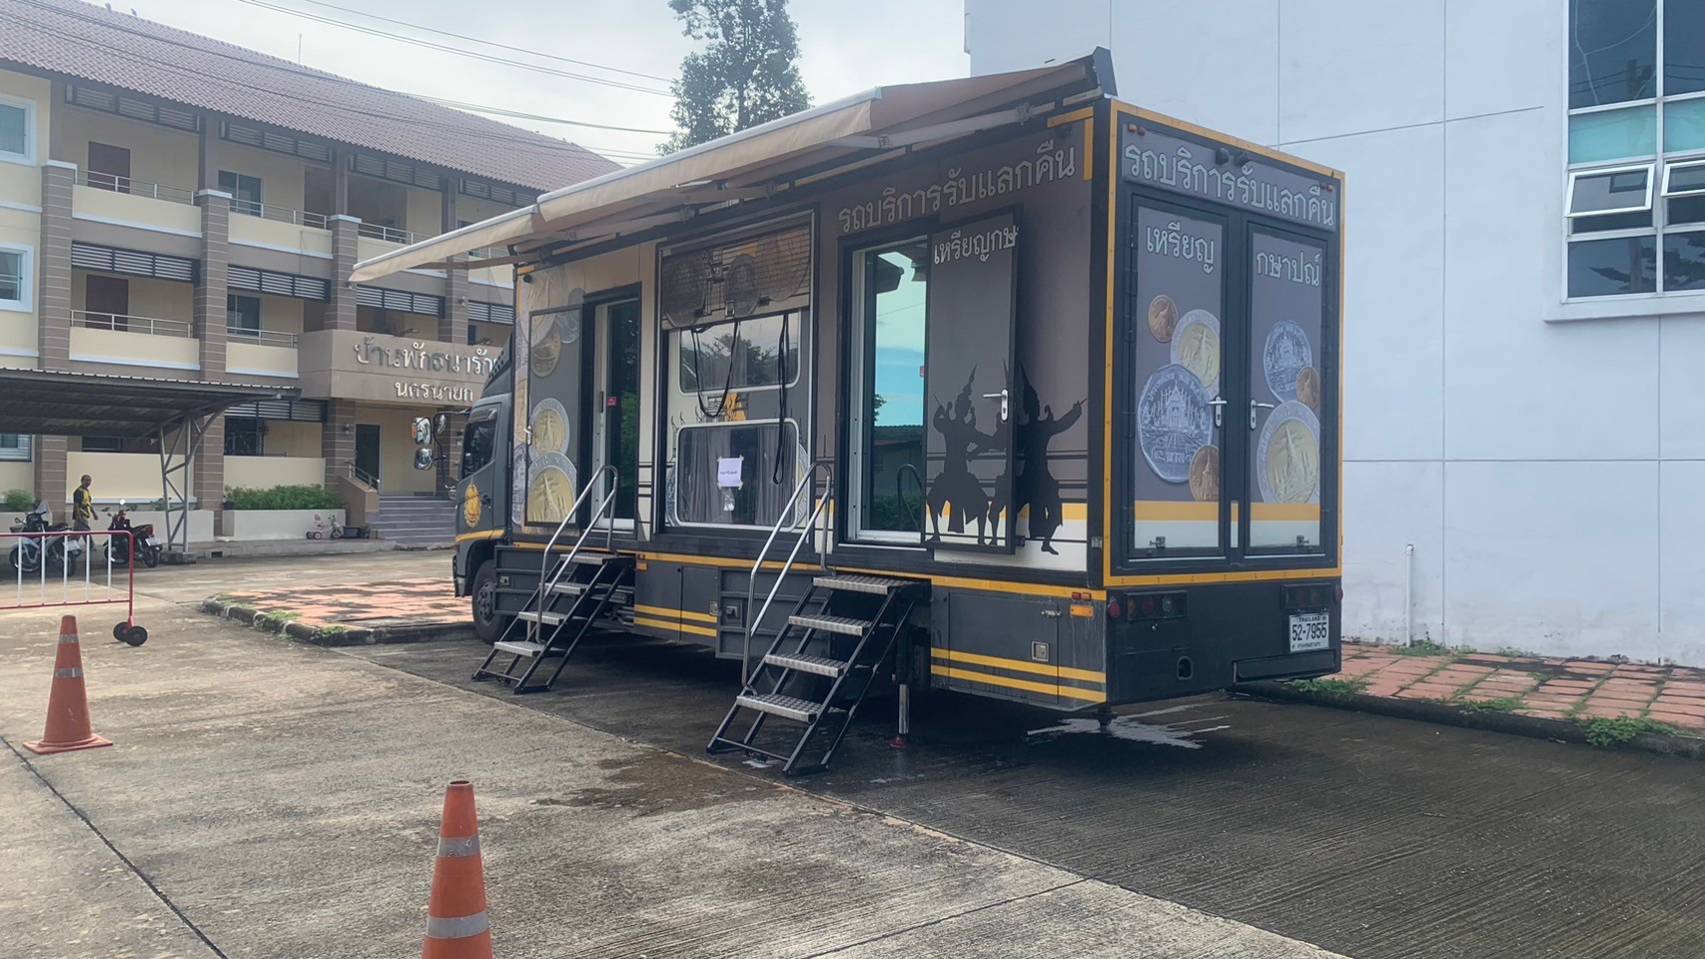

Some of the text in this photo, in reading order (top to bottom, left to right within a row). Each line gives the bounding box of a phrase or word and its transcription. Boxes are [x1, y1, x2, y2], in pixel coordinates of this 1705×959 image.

[838, 139, 1076, 233] รถบริการรับแลกคืน
[1125, 144, 1335, 227] รถบริการรับแลกคืน
[1146, 221, 1321, 287] เหรียญ กษาปณ์
[353, 336, 499, 375] บ้านพักธนารัก
[394, 381, 474, 402] นครนายก
[1291, 621, 1328, 641] 52-7955
